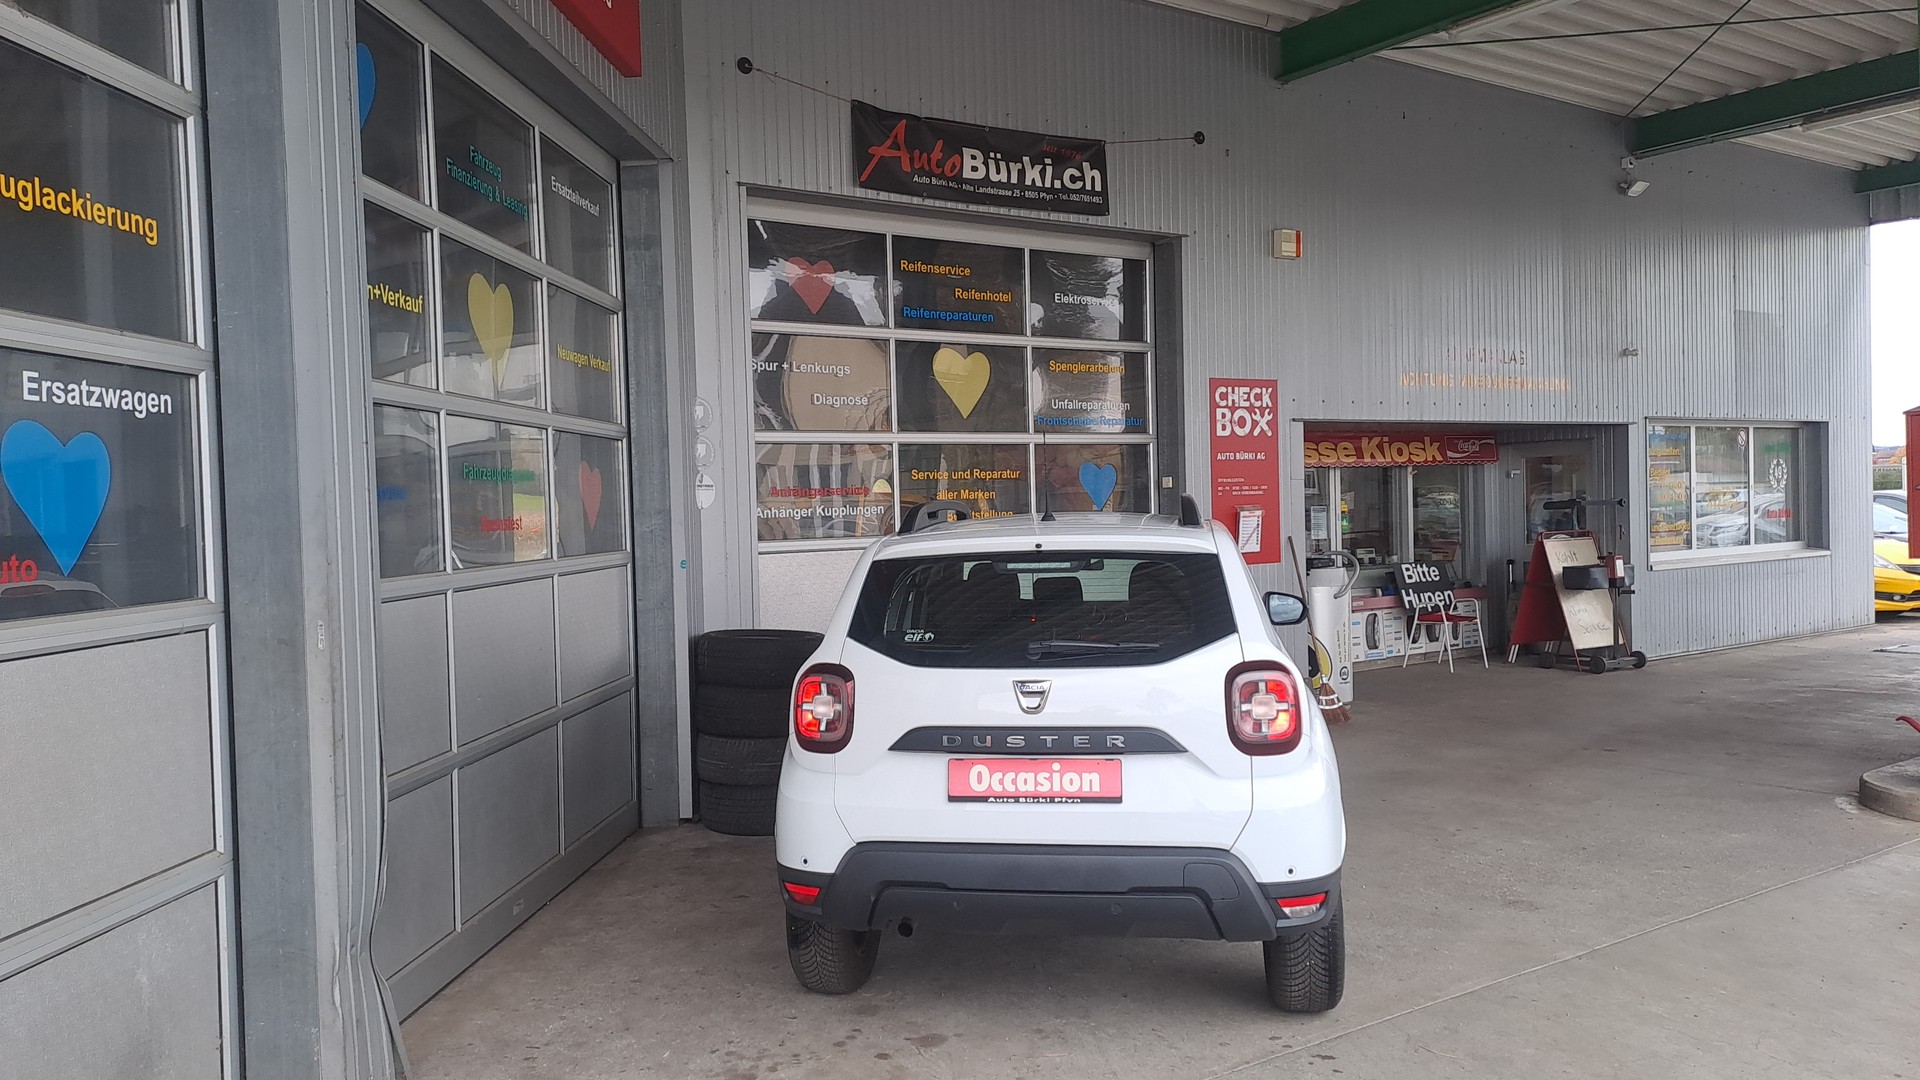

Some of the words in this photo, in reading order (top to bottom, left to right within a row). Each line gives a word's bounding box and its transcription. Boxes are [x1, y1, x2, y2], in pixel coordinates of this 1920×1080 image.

[469, 145, 502, 182] Fahrzeug
[446, 157, 493, 202] Finanzierung
[495, 185, 501, 203] &
[502, 189, 528, 221] Leasing
[912, 173, 931, 184] Auto
[931, 176, 948, 187] Bürki
[961, 182, 974, 192] Alte
[975, 185, 1013, 197] Landstrasse
[1013, 189, 1021, 197] 25
[1024, 190, 1039, 199] 8505
[550, 175, 600, 218] Ersatzteilverkauf
[0, 173, 158, 246] uglackierung
[900, 259, 971, 277] Reifenservice
[954, 287, 1012, 303] Reifenhotel
[903, 306, 994, 324] Reifenreparaturen
[557, 344, 588, 368] Neuwagen
[589, 352, 611, 372] Verkauf
[751, 358, 779, 374] Spur
[781, 361, 789, 370] +
[792, 360, 851, 377] Lenkungs
[22, 370, 172, 419] Ersatzwagen
[813, 393, 869, 409] Diagnose
[1215, 386, 1273, 408] CHECK
[1051, 398, 1131, 412] Unfallreparaturen
[1216, 408, 1273, 437] BOX
[1217, 452, 1235, 460] AUTO
[1235, 451, 1256, 460] BÜRKI
[1256, 452, 1266, 460] AG
[1361, 436, 1444, 463] Kiosk
[911, 468, 949, 480] Service
[951, 469, 971, 479] und
[973, 468, 1021, 481] Reparatur
[936, 489, 958, 500] aller
[960, 489, 996, 500] Marken
[756, 507, 813, 520] Anhänger
[816, 505, 885, 519] Kupplungen
[1401, 563, 1440, 583] Bitte
[1401, 588, 1455, 612] Hupen
[904, 633, 924, 642] elf
[942, 735, 1126, 748] DUSTER
[968, 762, 1100, 792] Occasion
